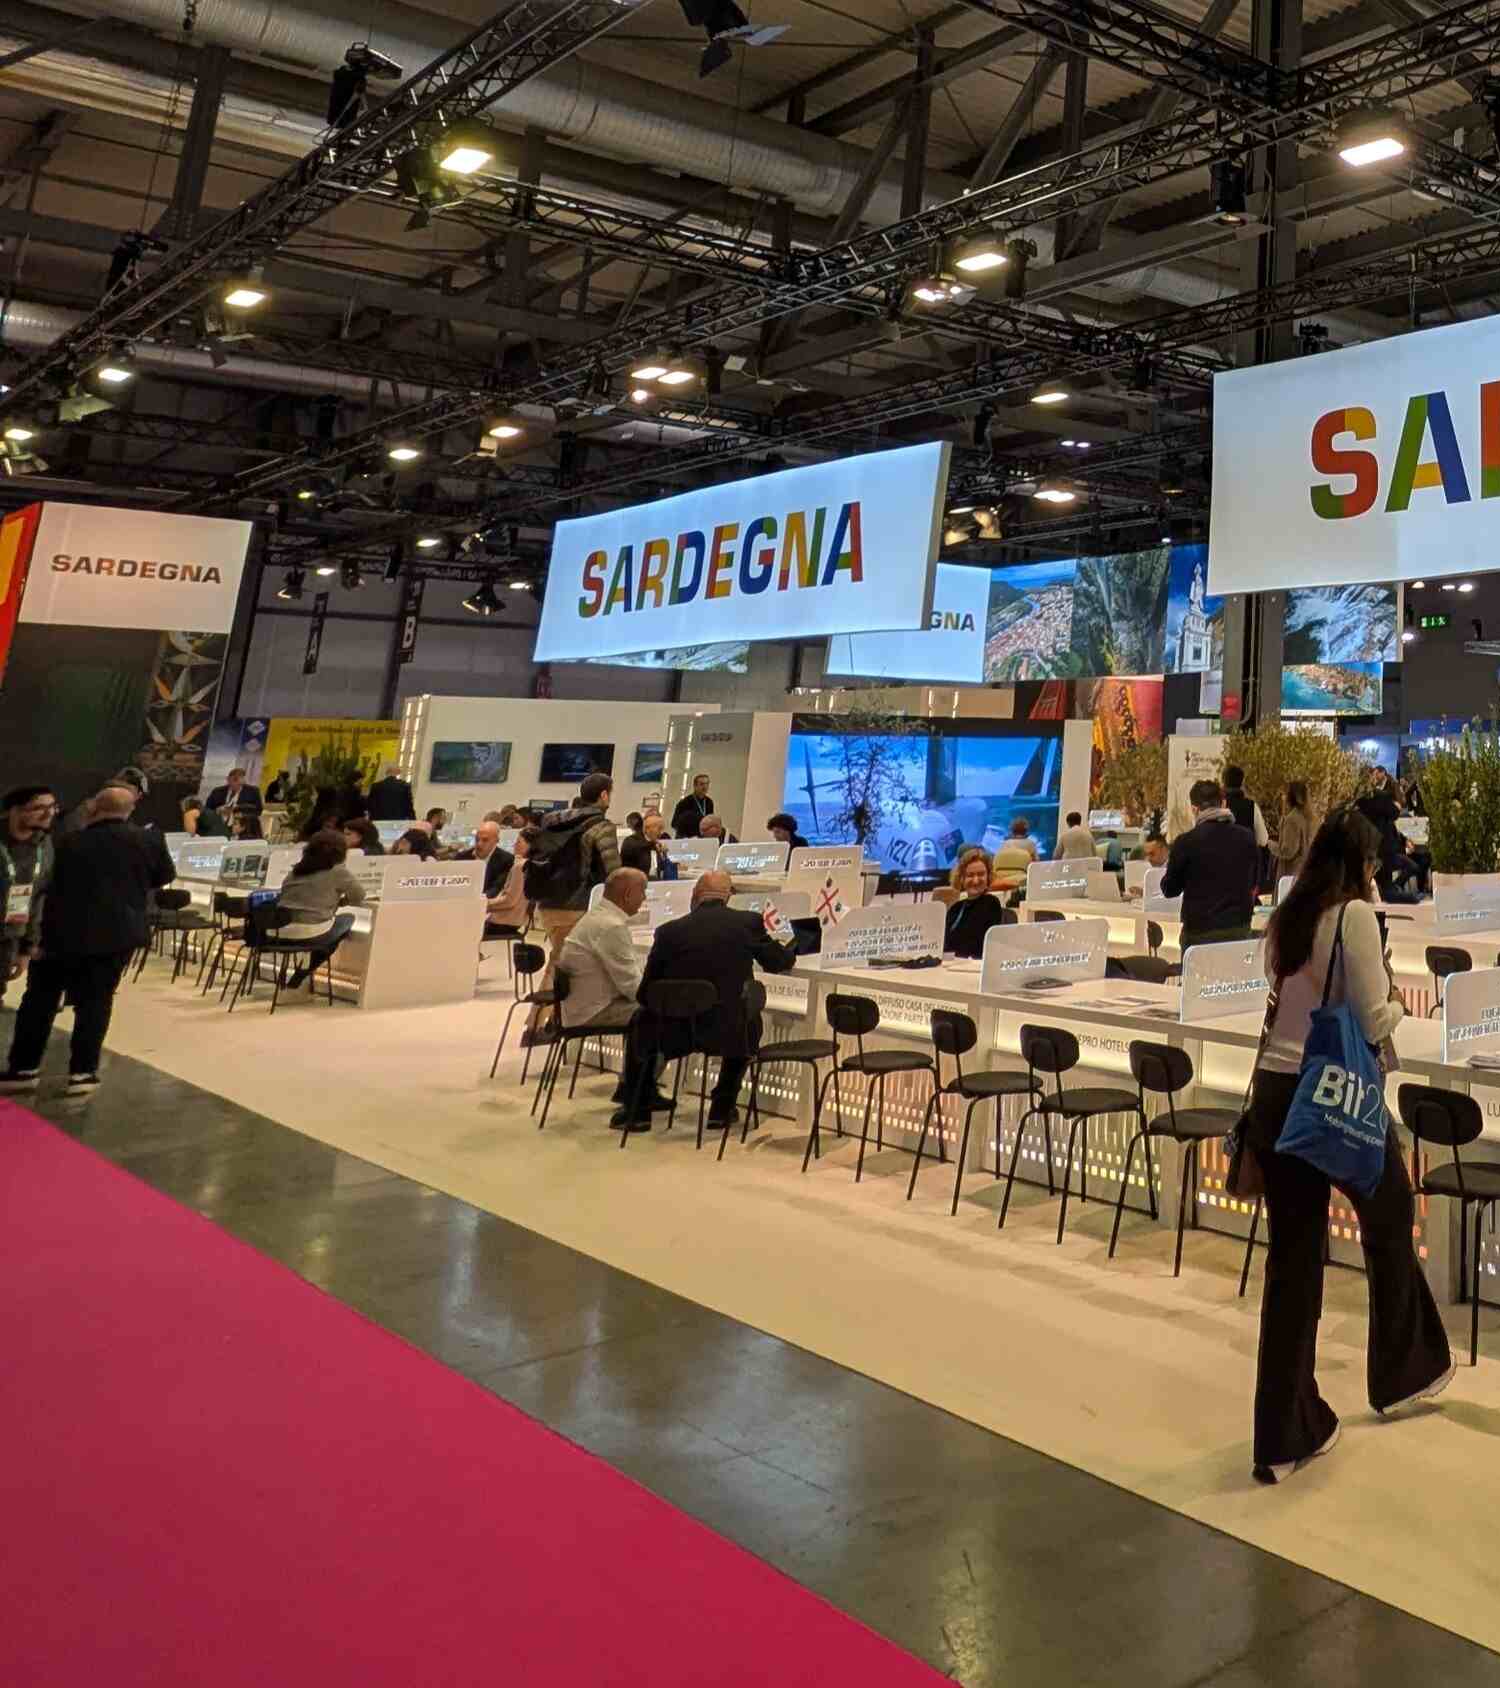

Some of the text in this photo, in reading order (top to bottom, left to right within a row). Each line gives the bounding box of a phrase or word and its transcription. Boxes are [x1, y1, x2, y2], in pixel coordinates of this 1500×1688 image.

[50, 554, 221, 585] SARDEGNA
[578, 502, 864, 618] SARDEGNA
[1099, 1038, 1130, 1053] HOTELS
